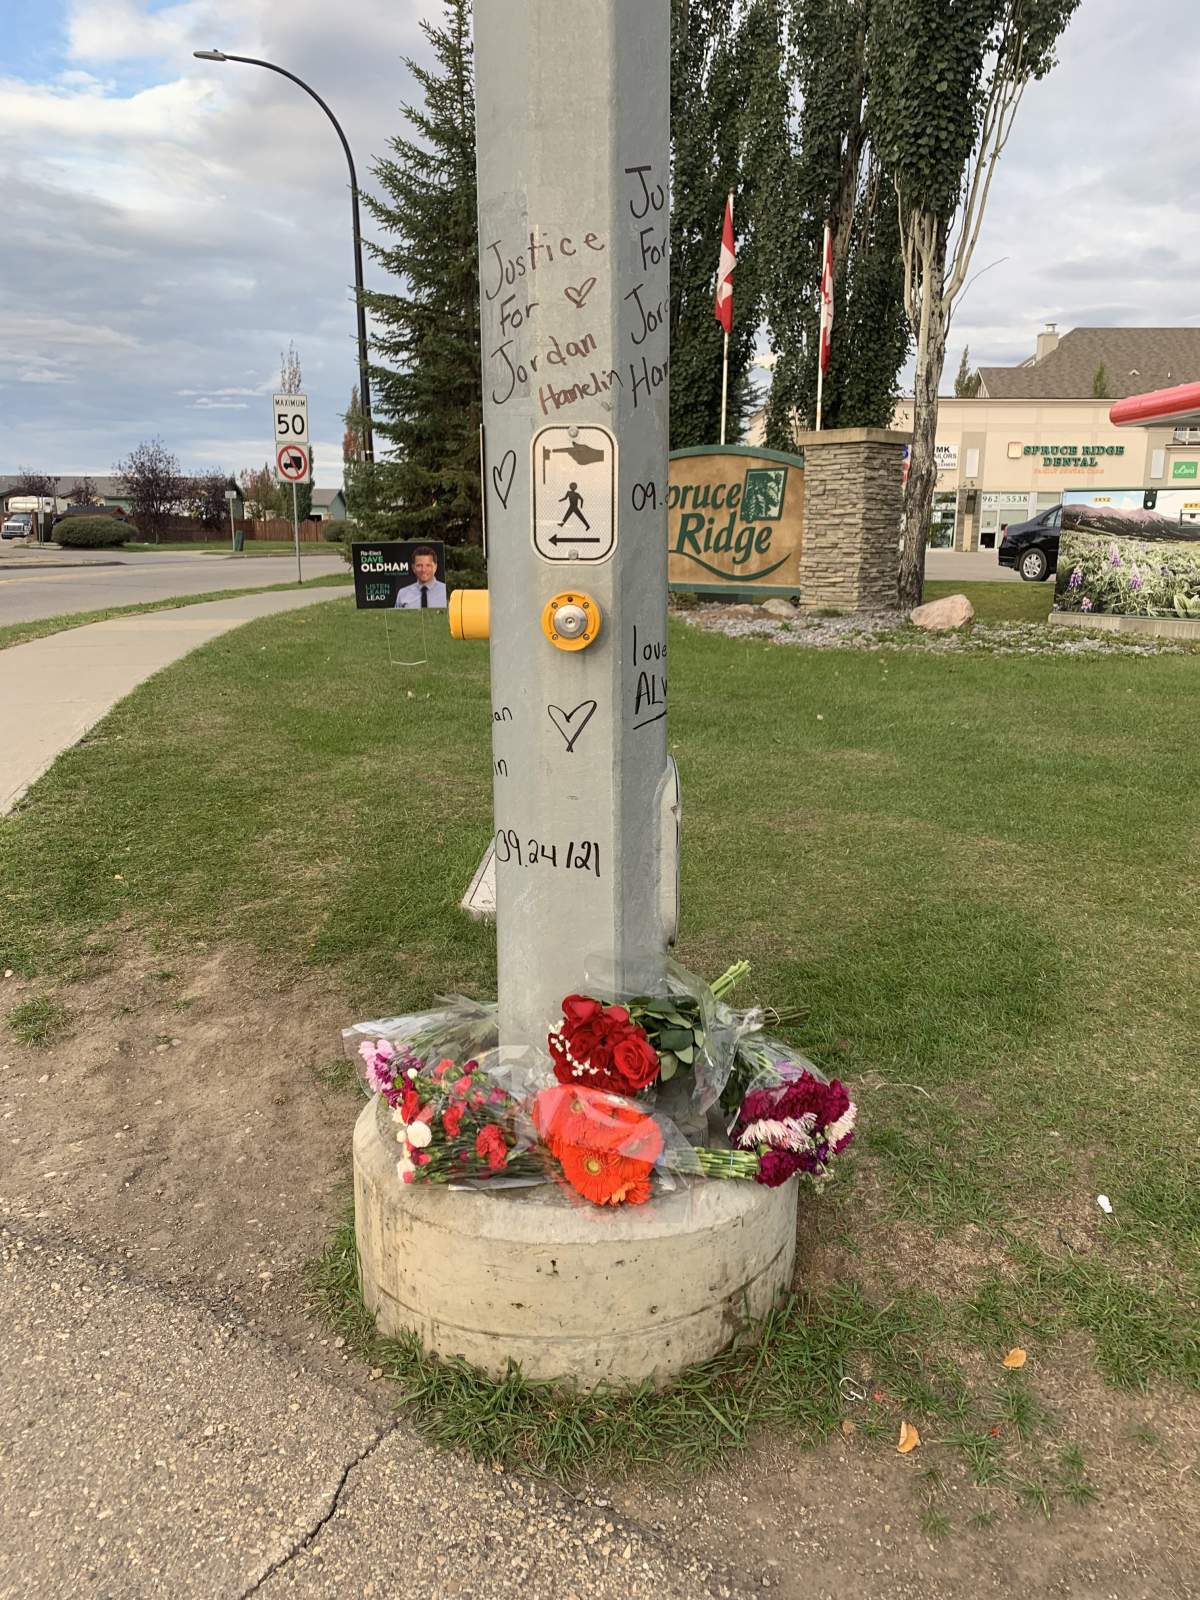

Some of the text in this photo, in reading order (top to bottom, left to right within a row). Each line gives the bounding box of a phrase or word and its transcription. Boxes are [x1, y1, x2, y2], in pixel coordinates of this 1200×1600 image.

[625, 165, 669, 219] Ju
[486, 232, 605, 300] Justice
[500, 294, 539, 336] For
[491, 333, 597, 404] Jordan
[539, 369, 624, 415] Hamelin
[277, 413, 305, 435] 50
[1023, 446, 1125, 455] SPRUCE RIDGE
[1043, 457, 1098, 466] DENTAL
[632, 482, 668, 511] 09.
[676, 511, 773, 564] Ridge
[361, 562, 409, 572] OLDHAM
[633, 625, 667, 666] love
[492, 706, 513, 721] an
